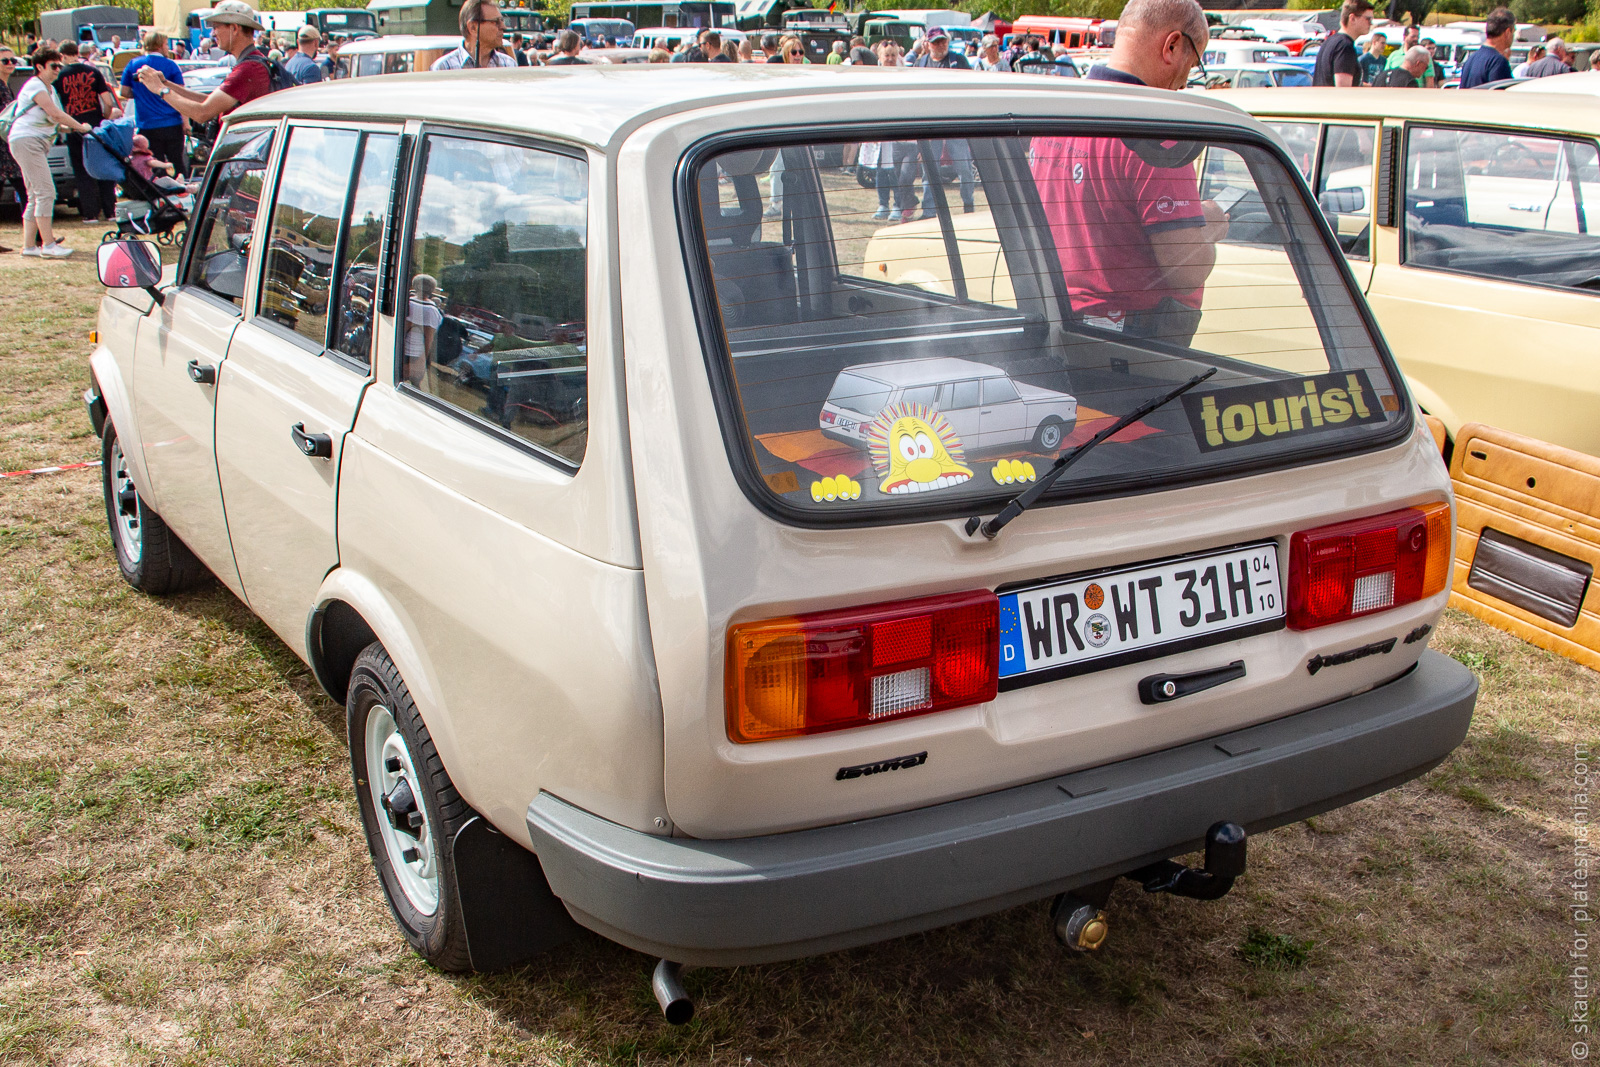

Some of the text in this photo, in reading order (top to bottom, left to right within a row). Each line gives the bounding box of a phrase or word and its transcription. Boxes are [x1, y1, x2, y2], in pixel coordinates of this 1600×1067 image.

[63, 71, 95, 94] CHAOS
[1201, 374, 1371, 447] tourist
[1253, 555, 1270, 573] 04
[1023, 593, 1085, 660] WR
[1110, 576, 1163, 642] WT
[1174, 559, 1254, 628] 31H
[1259, 593, 1275, 611] 10
[1003, 644, 1016, 662] D
